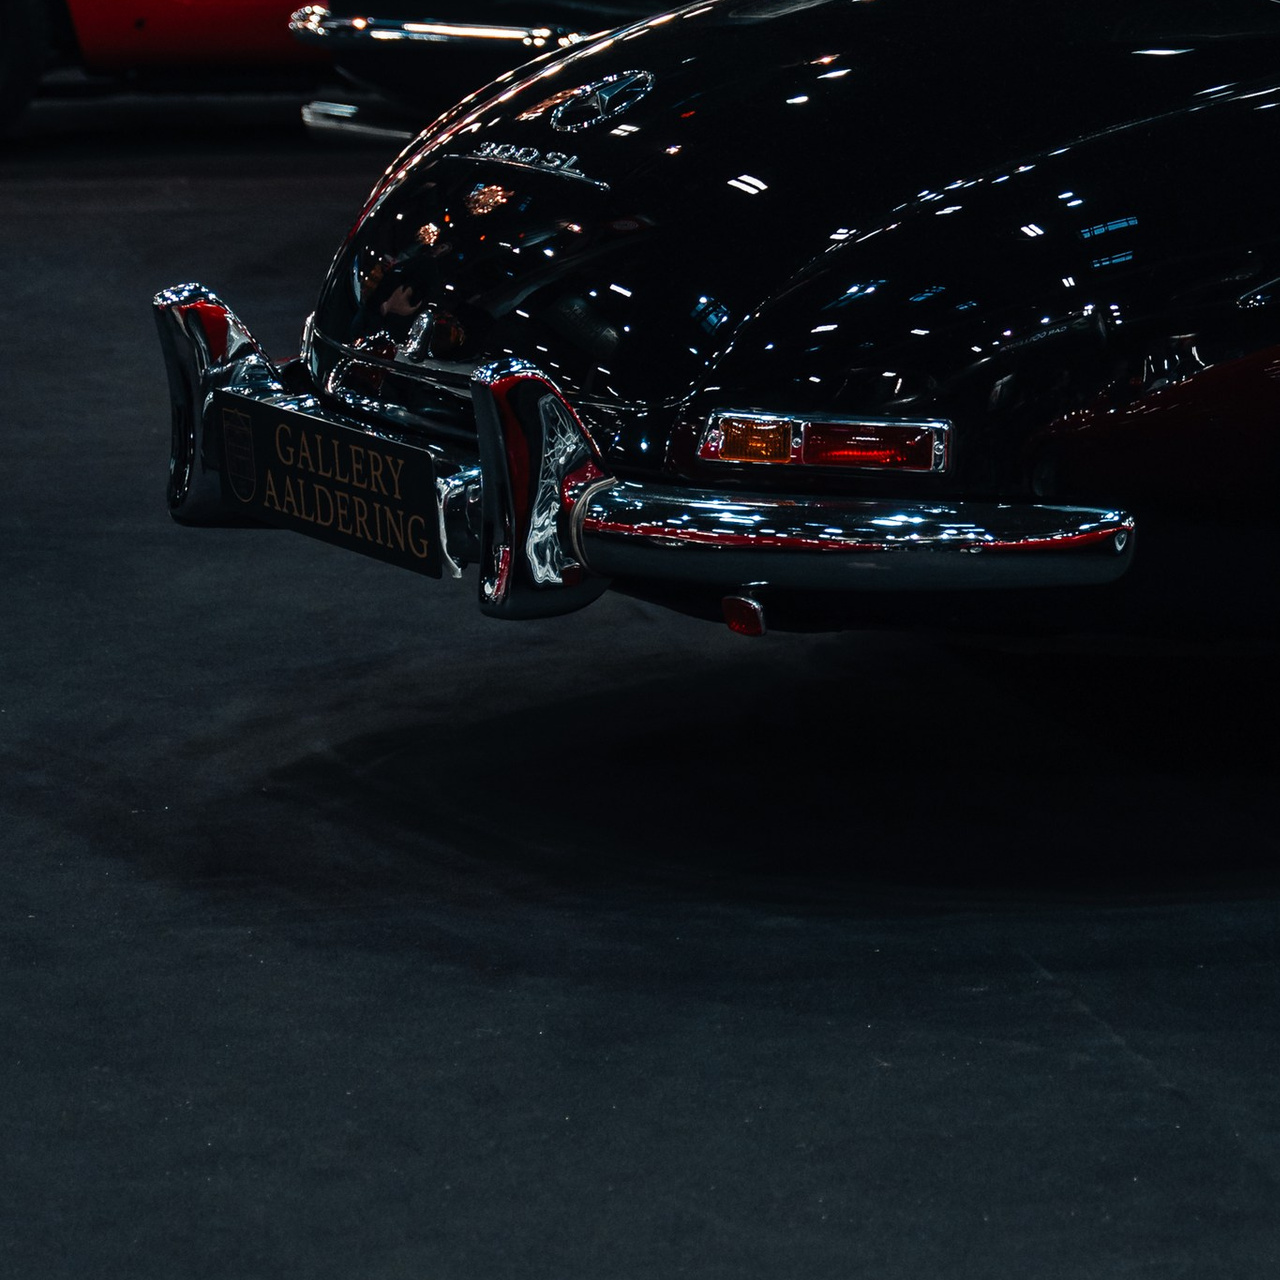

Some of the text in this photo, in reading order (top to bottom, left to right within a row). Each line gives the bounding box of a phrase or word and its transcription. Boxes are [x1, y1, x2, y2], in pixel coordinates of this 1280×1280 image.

[473, 141, 585, 177] 300 SL
[275, 423, 405, 500] GALLERY
[263, 469, 429, 559] AALDERING
